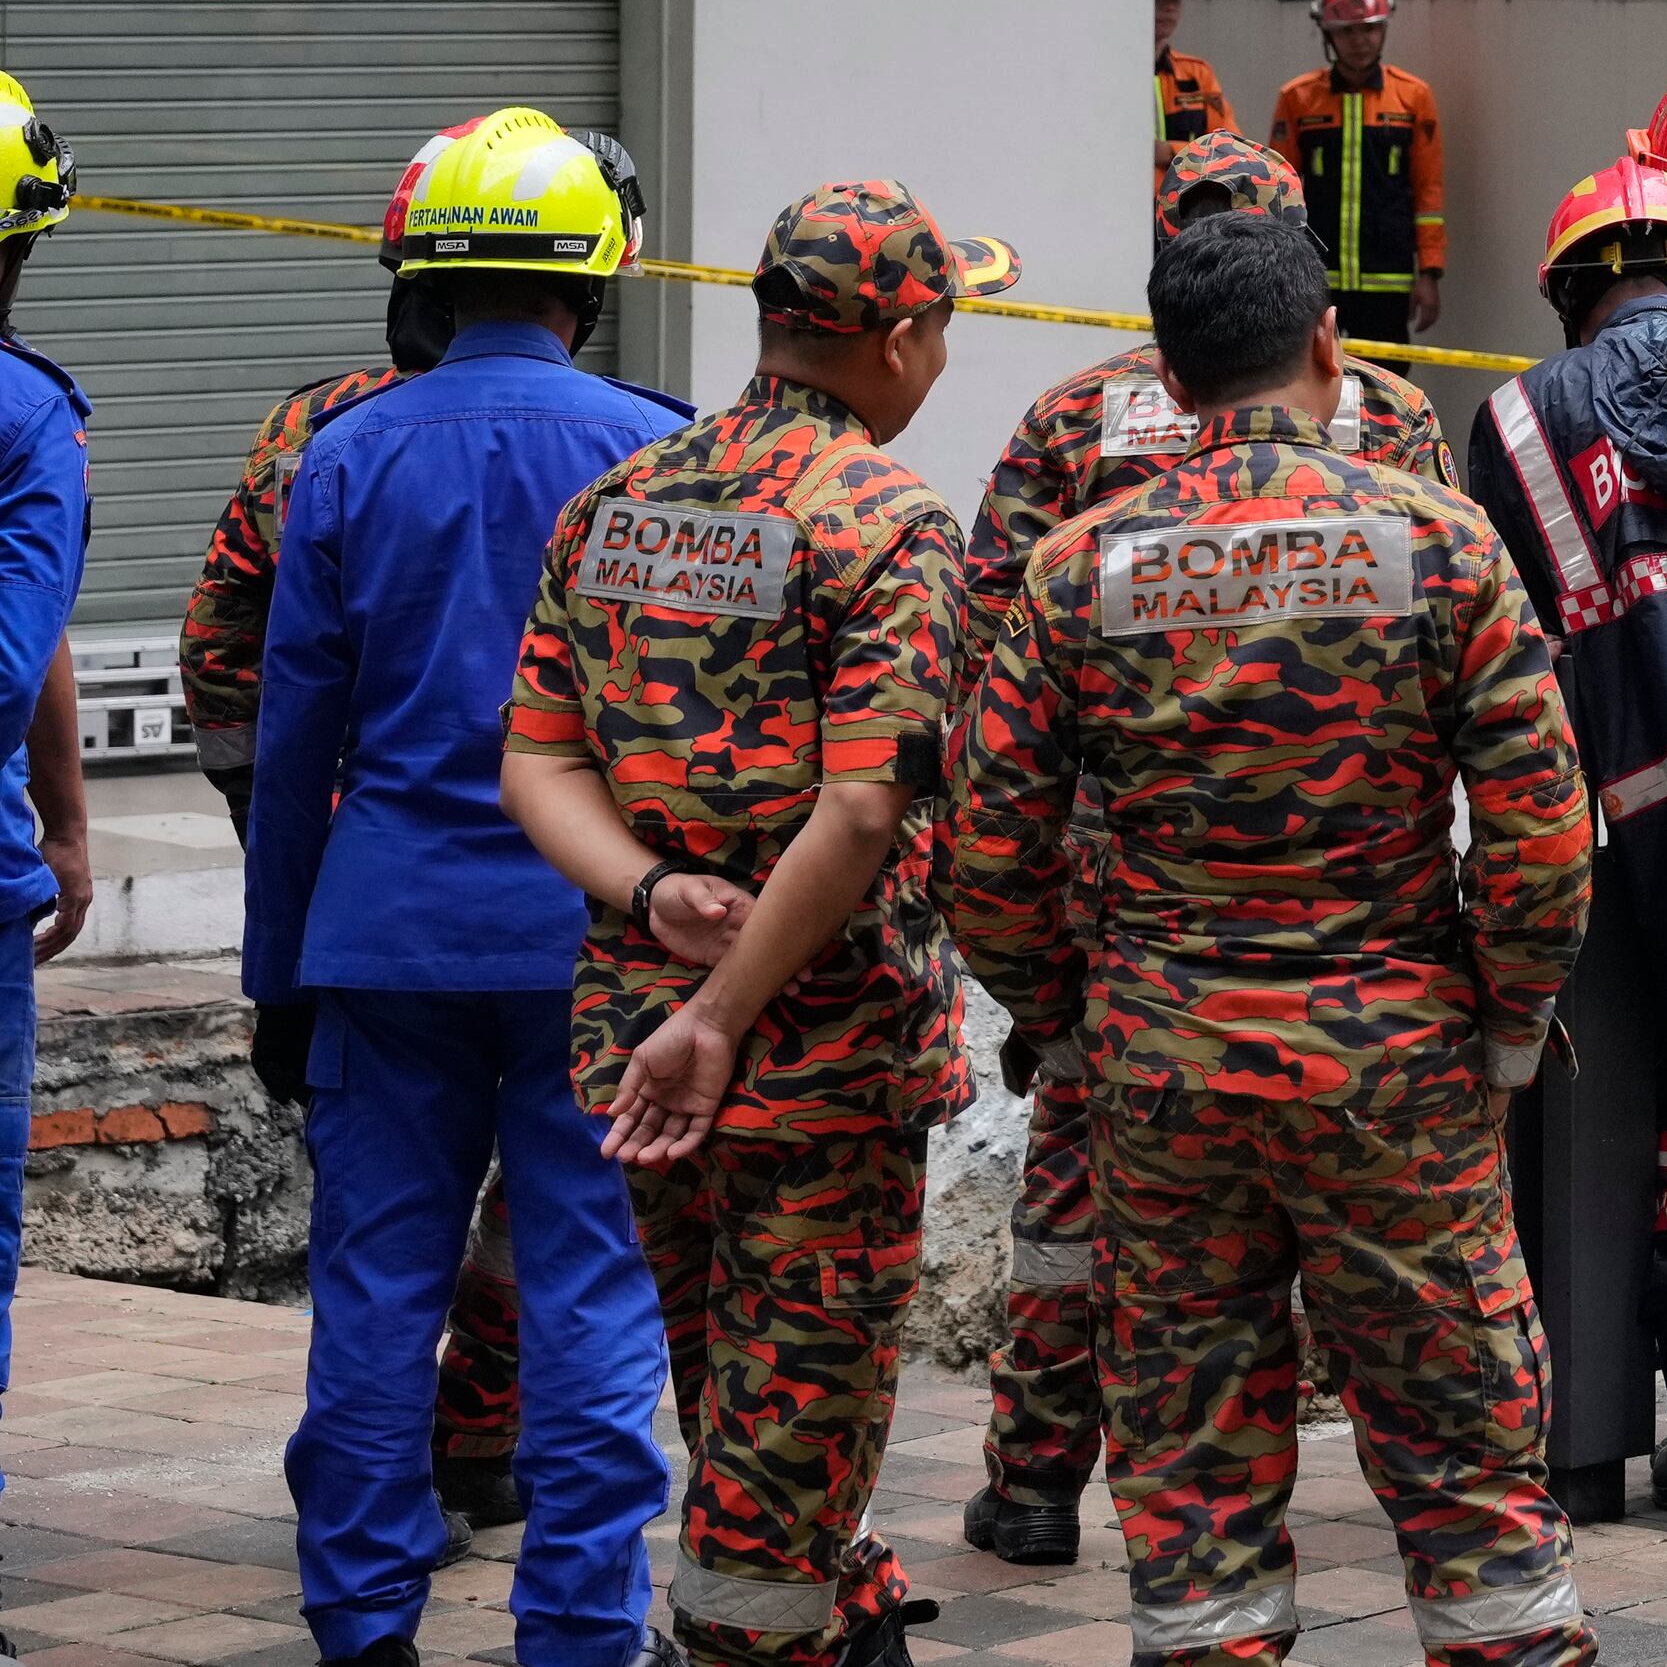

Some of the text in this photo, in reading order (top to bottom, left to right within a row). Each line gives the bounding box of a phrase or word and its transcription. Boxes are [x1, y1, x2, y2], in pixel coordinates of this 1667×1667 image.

[408, 205, 539, 229] PERTAHANAN AWAM
[437, 241, 467, 251] MSA
[556, 241, 587, 250] MSA
[601, 510, 764, 570] BOMBA
[1131, 529, 1379, 585] BOMBA
[595, 556, 757, 606] MALAYSIA
[1131, 576, 1381, 622] MALAYSIA
